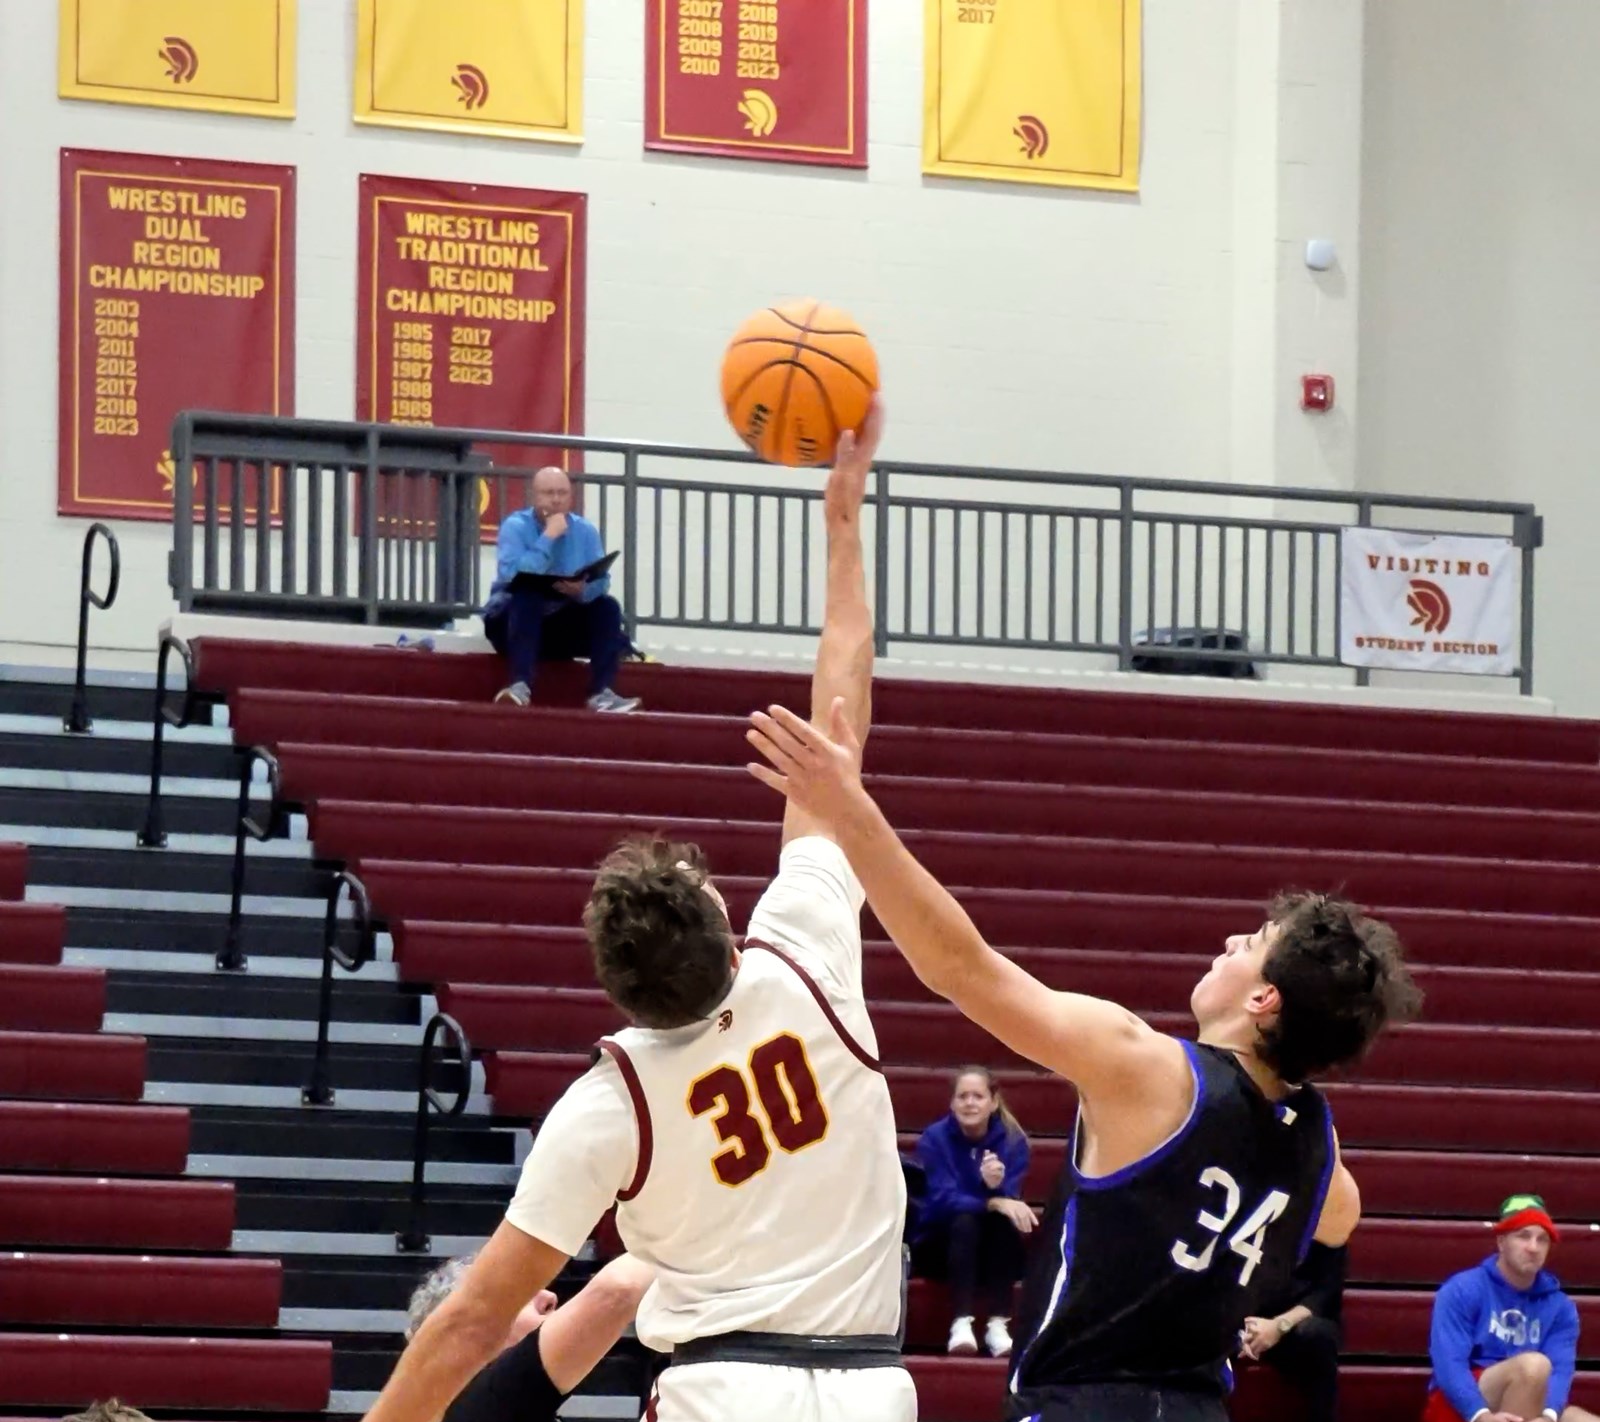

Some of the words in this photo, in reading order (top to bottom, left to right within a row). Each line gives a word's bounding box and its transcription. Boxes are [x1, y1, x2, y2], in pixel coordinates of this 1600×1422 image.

[678, 0, 723, 18] 2007
[738, 4, 778, 23] 2018
[958, 7, 995, 24] 2017
[678, 18, 722, 38] 2008
[738, 23, 777, 42] 2019
[678, 36, 722, 57] 2009
[738, 42, 777, 61] 2021
[680, 56, 720, 76] 2010
[737, 60, 780, 80] 2023
[108, 186, 247, 219] WRESTLING
[145, 216, 210, 243] DUAL
[405, 211, 540, 245] WRESTLING
[133, 241, 220, 270] REGION
[396, 237, 549, 272] TRADITIONAL
[89, 264, 264, 299] CHAMPIONSHIP
[429, 266, 514, 295] REGION
[94, 298, 139, 318] 2003
[386, 288, 556, 323] CHAMPIONSHIP
[94, 318, 139, 338] 2004
[393, 322, 433, 341] 1985
[451, 326, 492, 346] 2017
[98, 338, 135, 357] 2011
[392, 341, 433, 360] 1986
[449, 346, 493, 366] 2022
[96, 358, 137, 377] 2012
[392, 361, 433, 380] 1987
[449, 365, 493, 385] 2023
[95, 378, 137, 396] 2017
[392, 380, 432, 399] 1988
[95, 397, 137, 416] 2018
[391, 399, 432, 418] 1989
[94, 416, 139, 436] 2023
[1367, 554, 1490, 576] VISITING
[1355, 637, 1426, 652] STUDENT
[1433, 642, 1498, 655] SECTION
[685, 1030, 829, 1189] 30
[1170, 1166, 1290, 1286] 34
